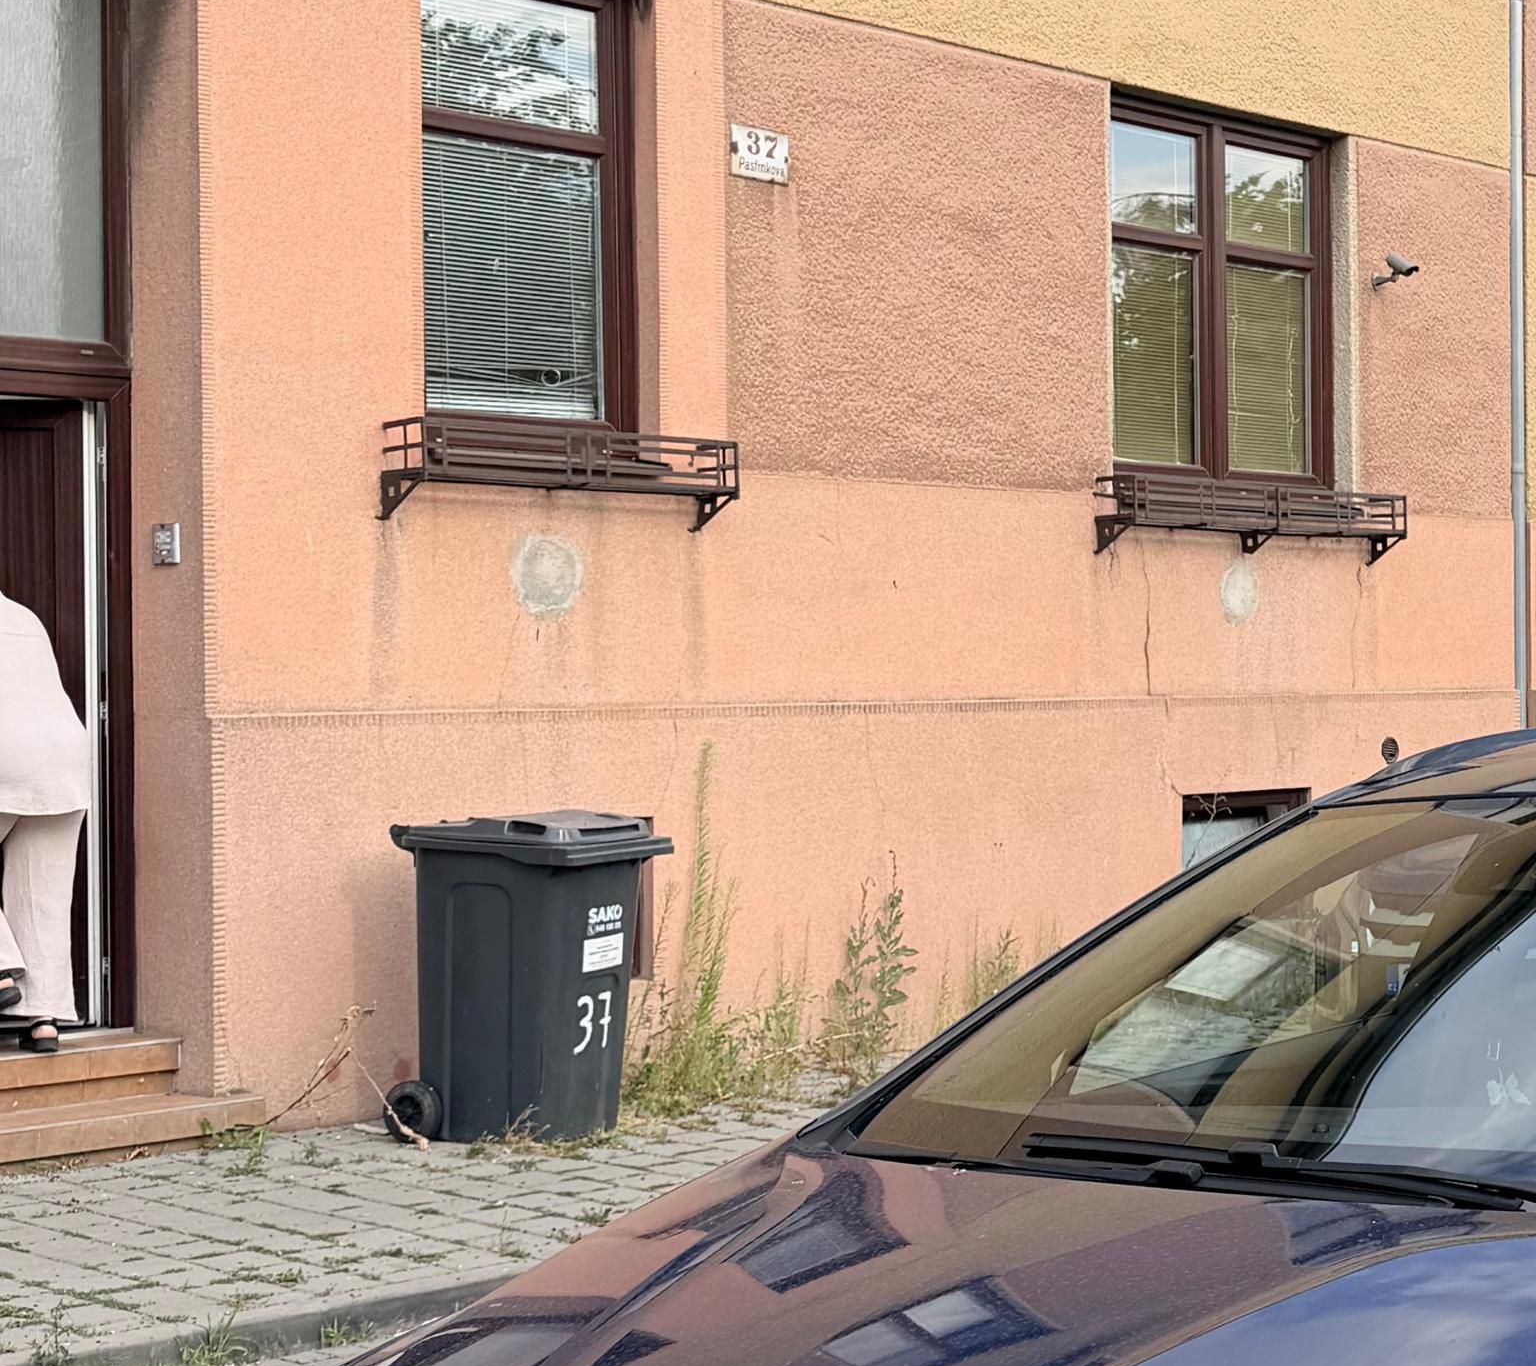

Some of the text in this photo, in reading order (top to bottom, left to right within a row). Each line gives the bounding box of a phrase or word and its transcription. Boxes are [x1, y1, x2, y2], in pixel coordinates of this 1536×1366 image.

[746, 130, 778, 160] 37
[588, 903, 623, 924] SAKO
[573, 990, 612, 1055] 37
